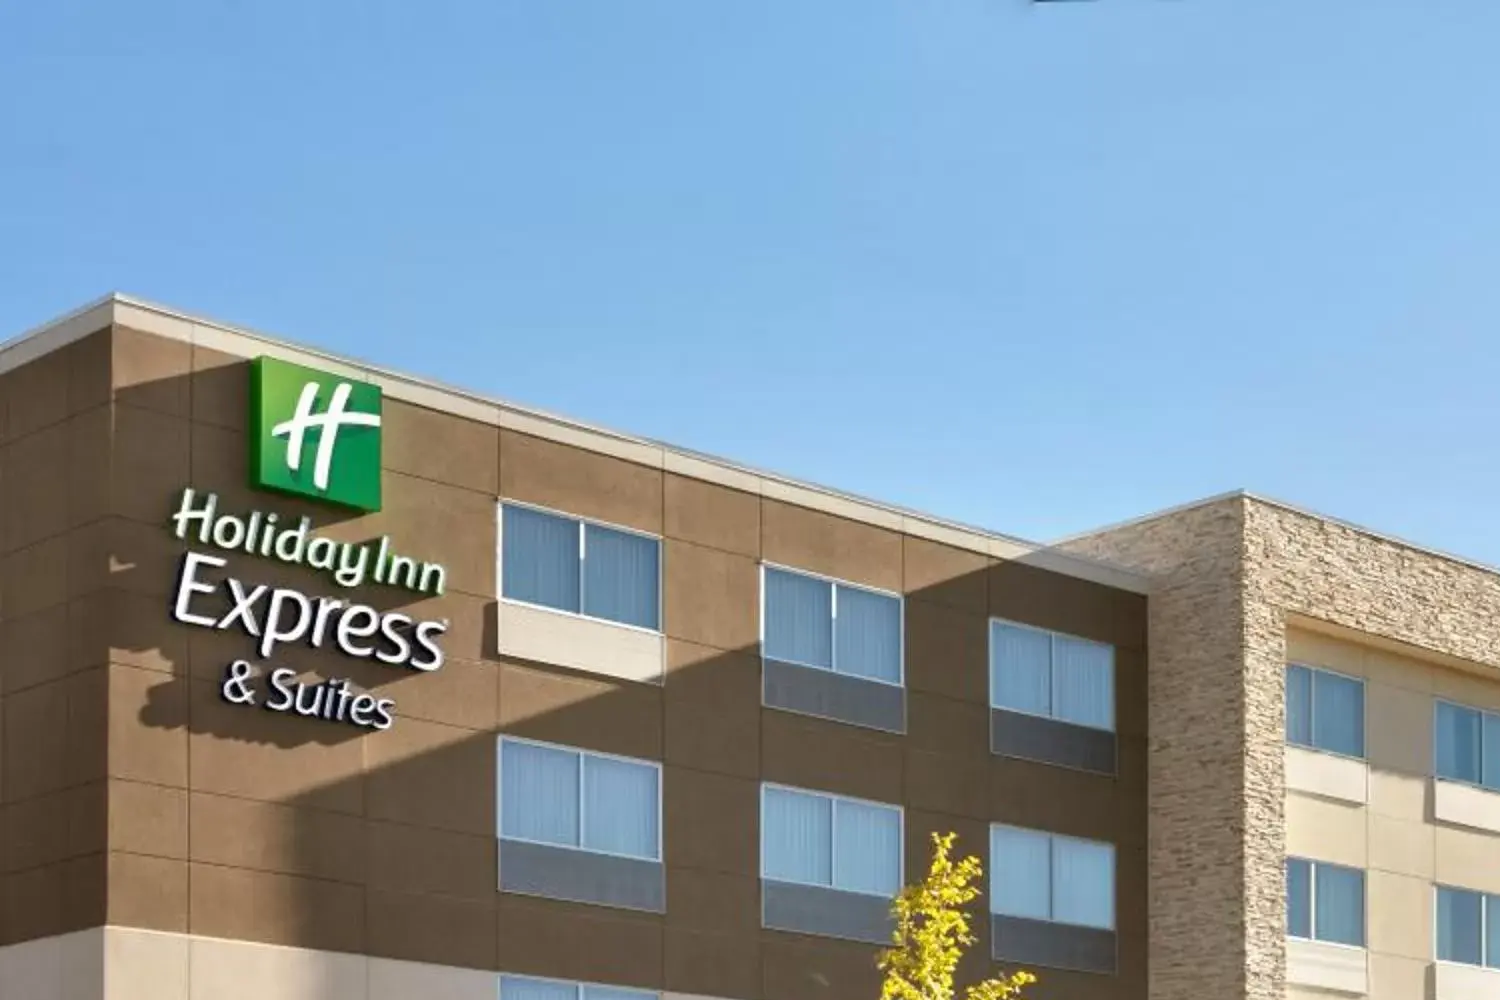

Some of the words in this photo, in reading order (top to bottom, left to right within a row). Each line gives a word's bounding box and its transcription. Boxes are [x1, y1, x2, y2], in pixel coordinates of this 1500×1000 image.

[173, 488, 370, 588] Holiday
[375, 536, 447, 596] Inn
[174, 551, 448, 672] Express
[222, 659, 256, 705] &
[267, 667, 395, 730] Suites
